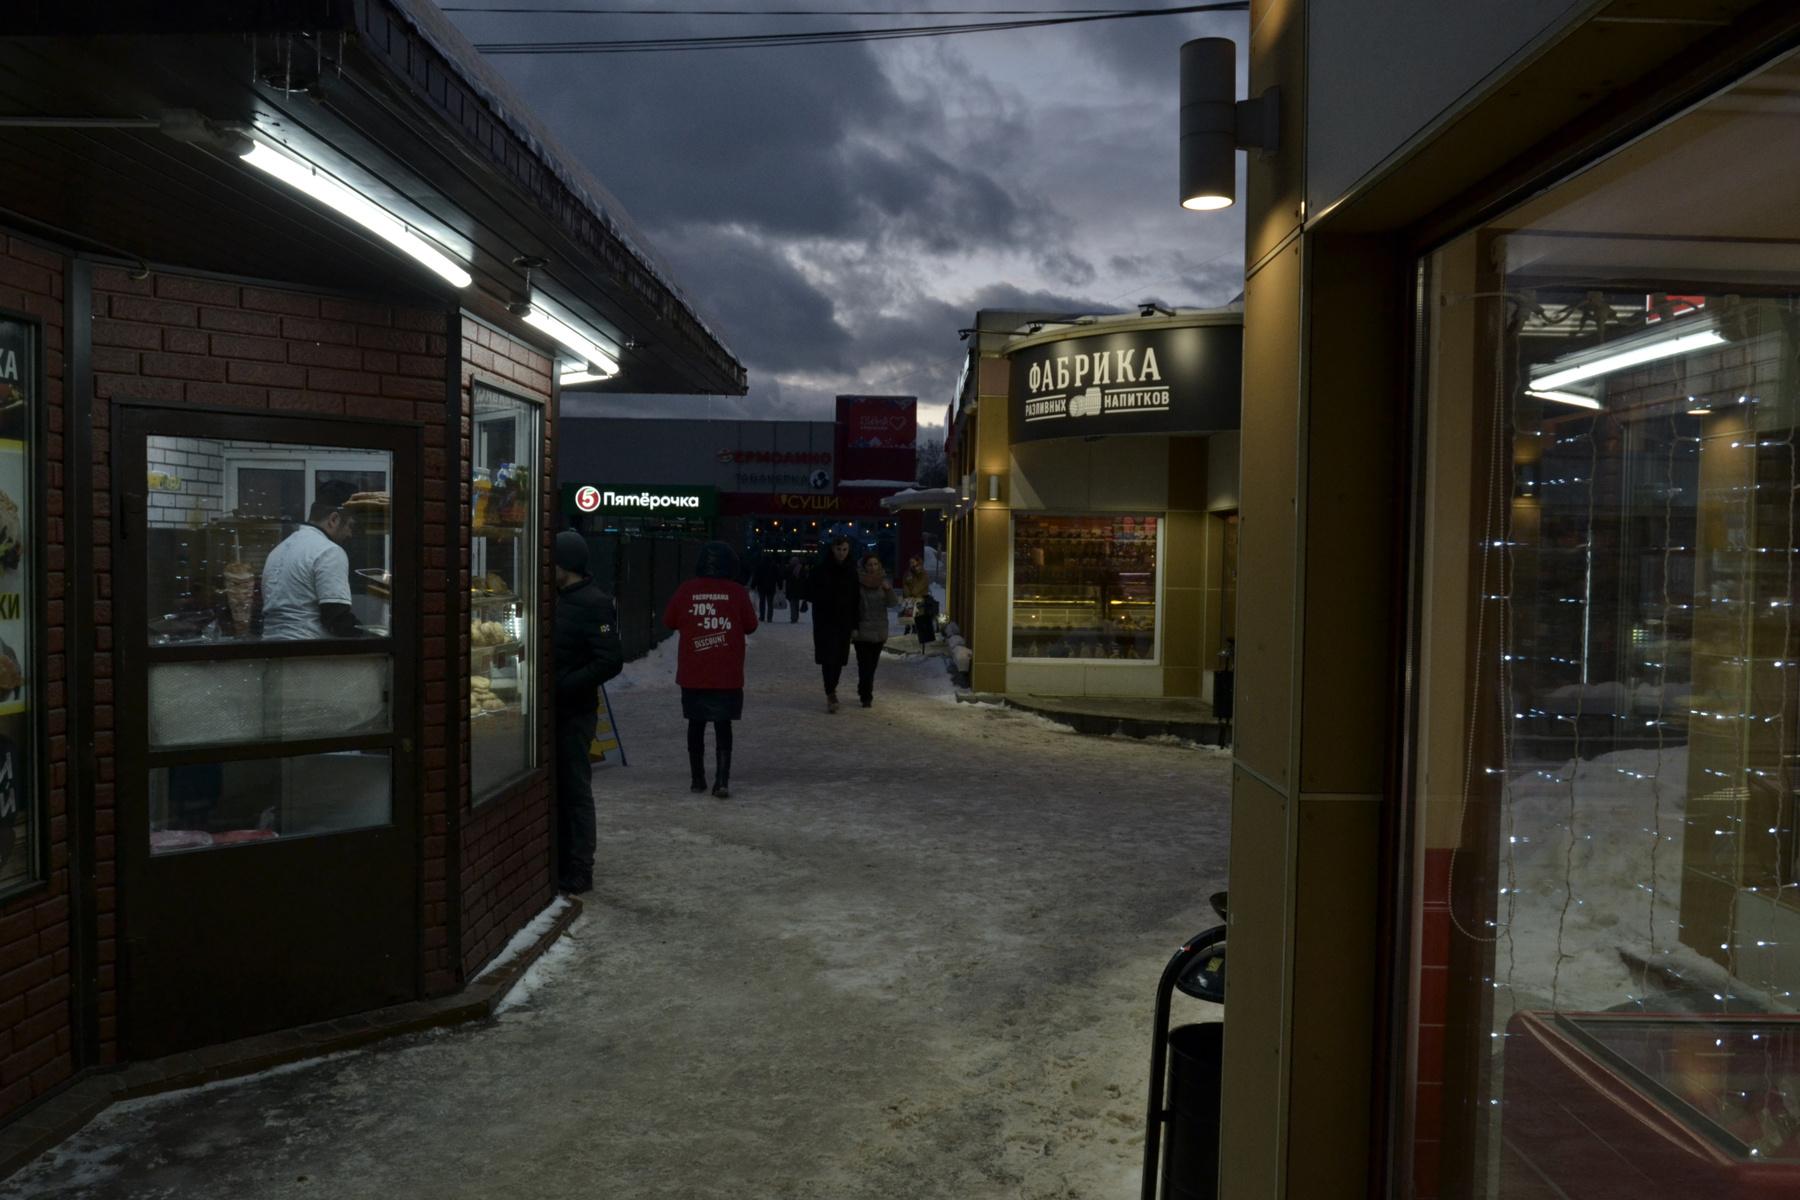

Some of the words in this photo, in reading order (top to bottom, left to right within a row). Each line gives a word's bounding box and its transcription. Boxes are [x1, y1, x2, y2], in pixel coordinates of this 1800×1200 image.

[1028, 347, 1162, 394] ФАБРИКА
[1025, 398, 1067, 417] РАЗЛИВНЫХ
[1104, 391, 1170, 409] НАПИТКОВ
[603, 491, 700, 511] Пятёрочка
[787, 495, 840, 510] СУШИ
[688, 603, 717, 616] -70%
[697, 617, 732, 630] -50%
